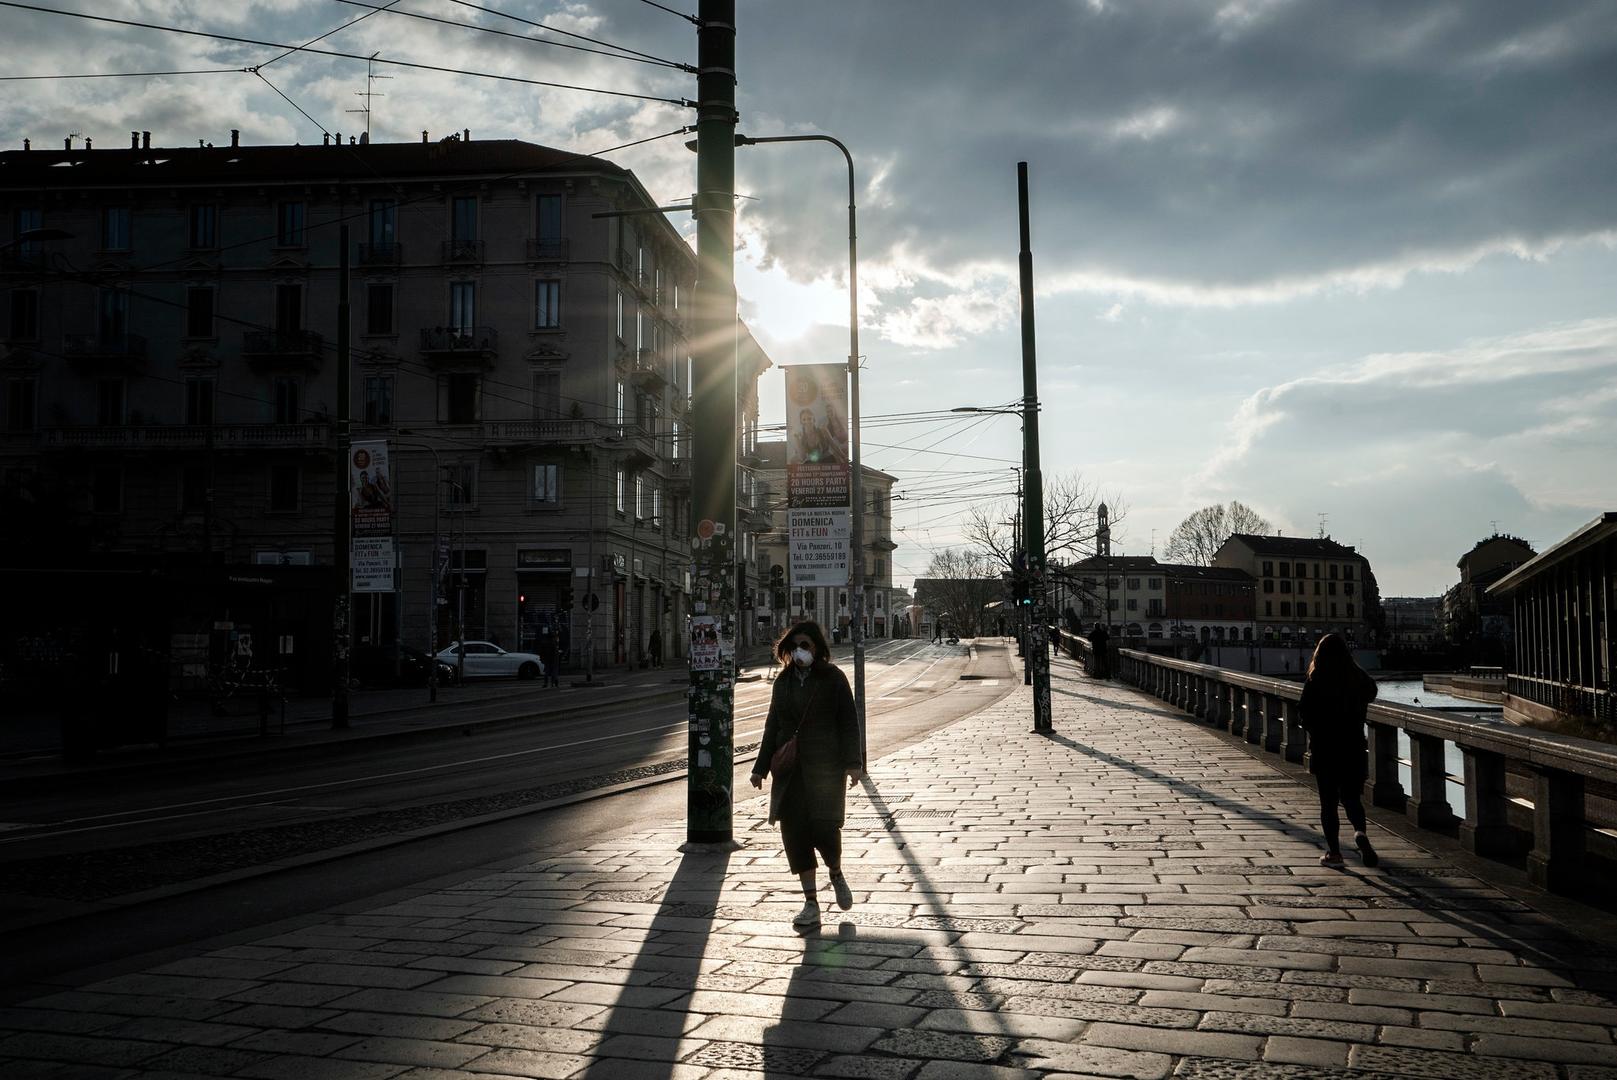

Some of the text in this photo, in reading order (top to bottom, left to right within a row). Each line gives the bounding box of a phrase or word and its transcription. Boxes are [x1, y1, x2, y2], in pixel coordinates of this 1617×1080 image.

[791, 476, 847, 486] 20 HOURS PARTY
[816, 486, 825, 494] 27
[825, 486, 848, 494] MARZO
[792, 517, 834, 527] DOMENICA
[792, 528, 805, 537] FIT
[811, 527, 828, 537] FUN
[796, 542, 808, 550] Via
[834, 541, 843, 550] 10
[793, 553, 804, 561] Tel.
